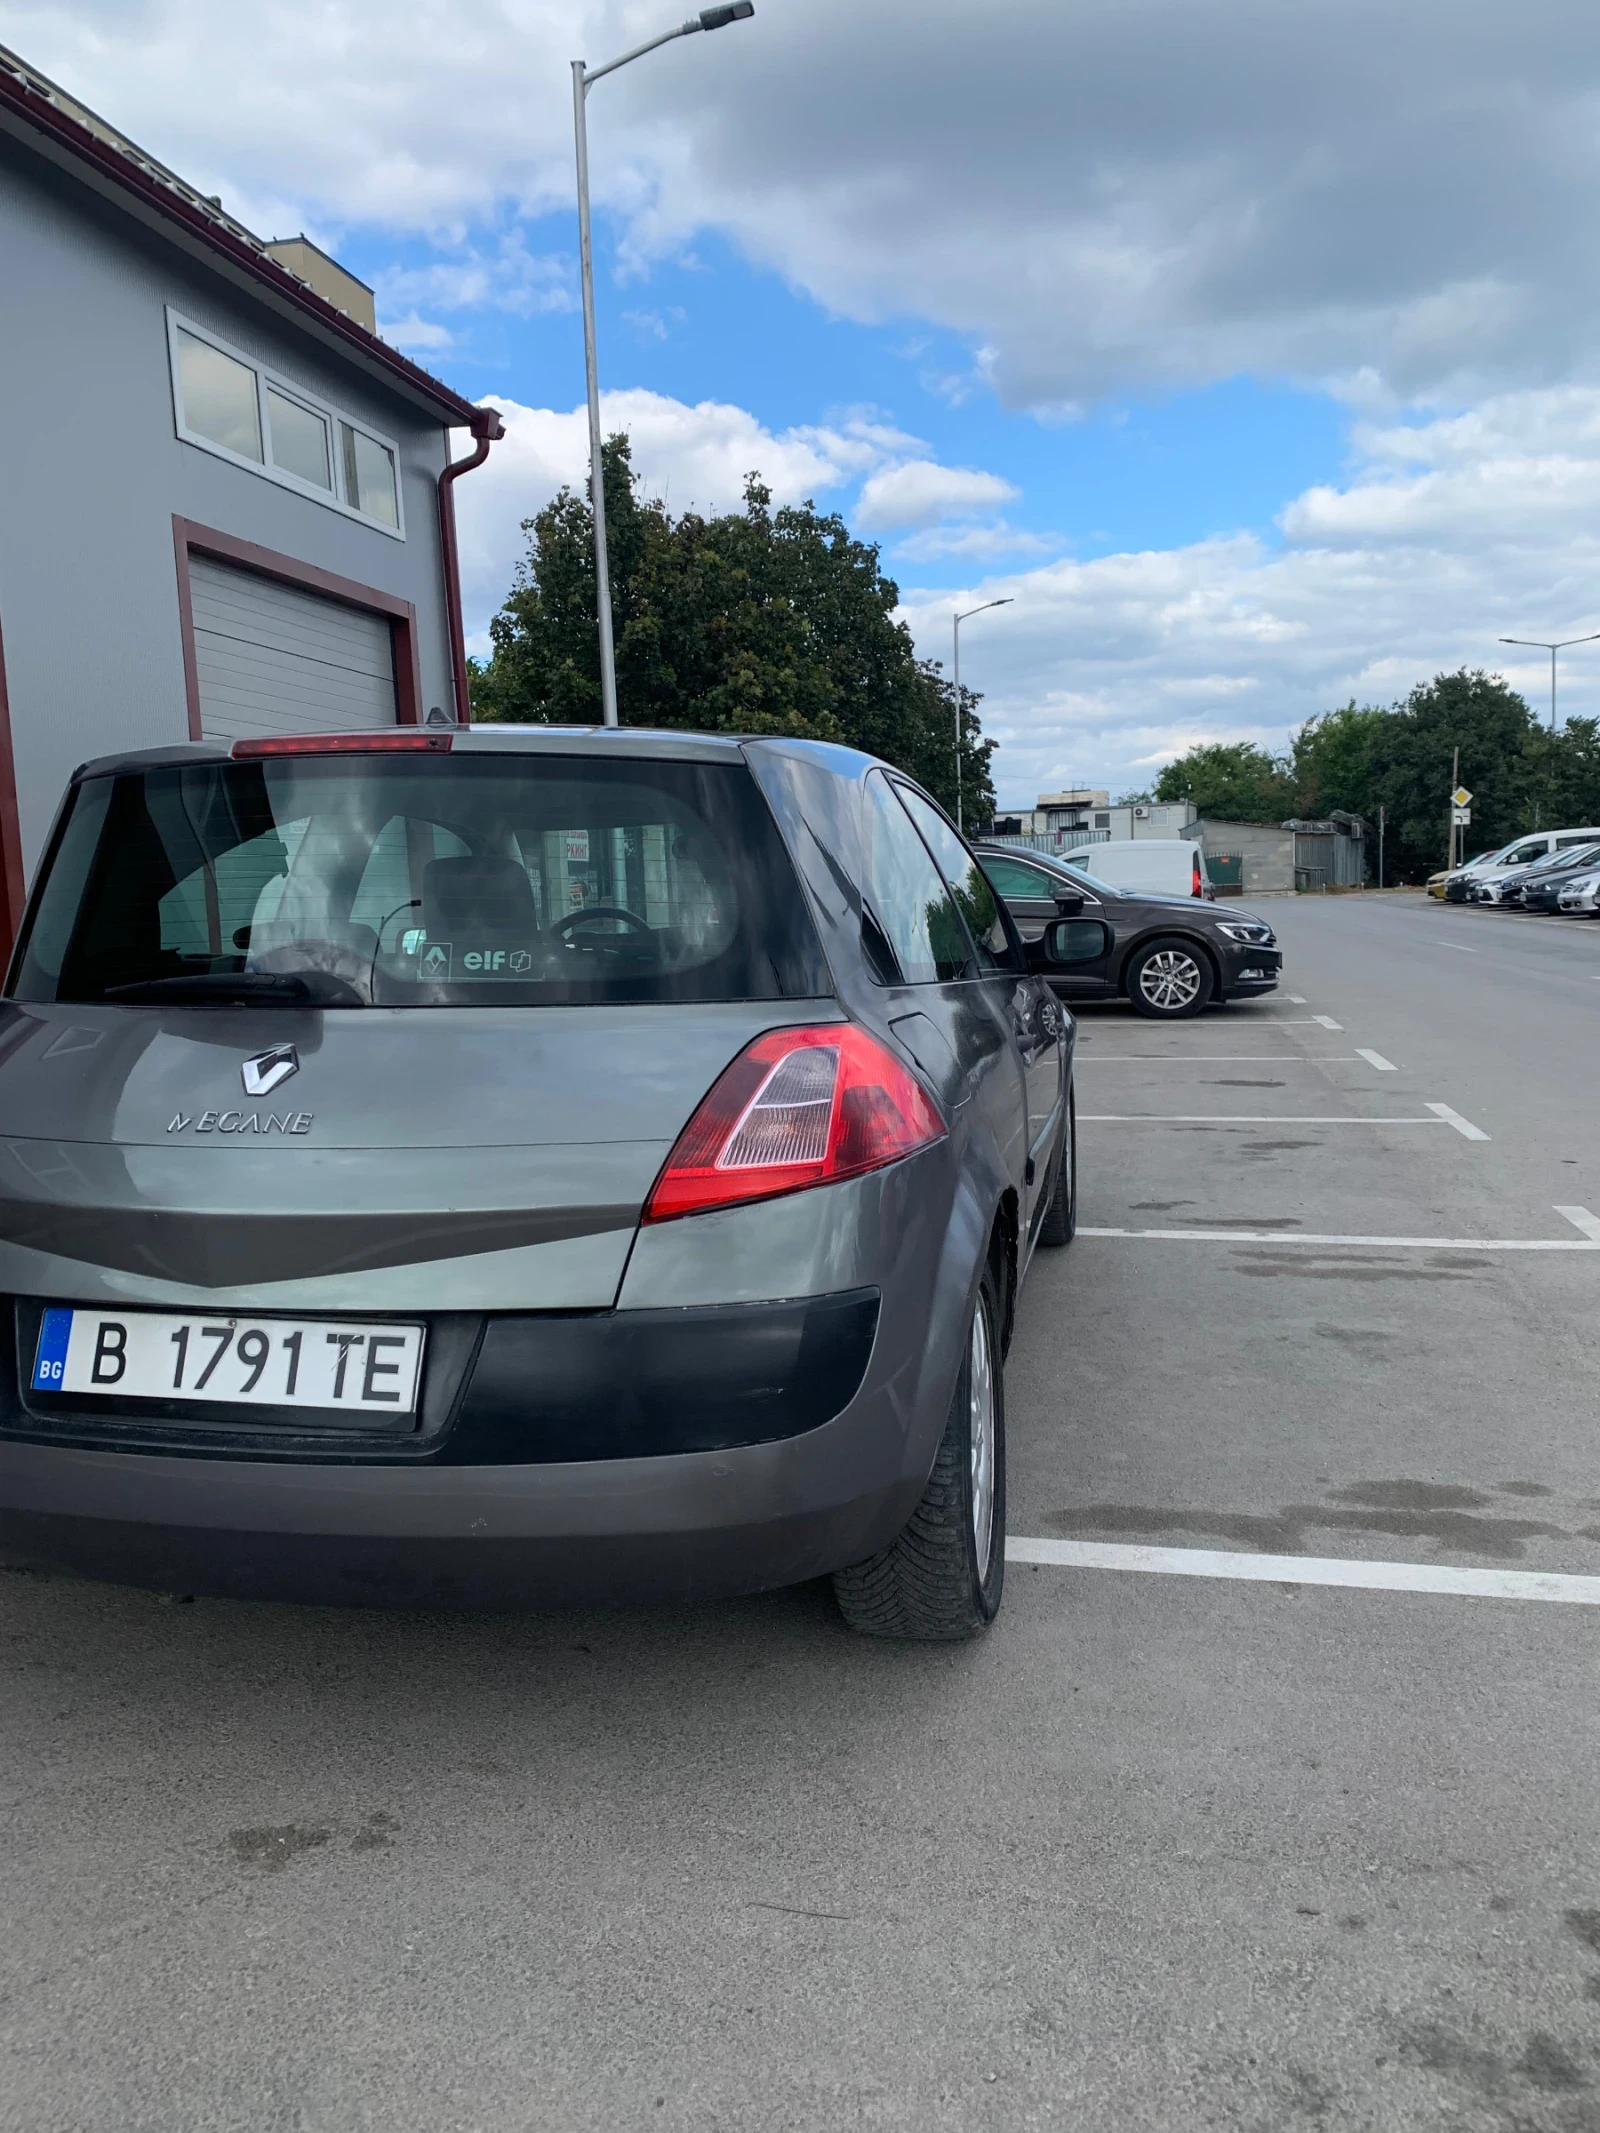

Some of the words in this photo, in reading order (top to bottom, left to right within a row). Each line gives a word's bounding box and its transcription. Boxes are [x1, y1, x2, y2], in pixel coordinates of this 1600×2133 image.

[463, 950, 505, 970] elf
[39, 1360, 63, 1380] BG
[91, 1322, 128, 1385] B
[171, 1326, 303, 1396] 1791
[326, 1333, 406, 1402] TE
